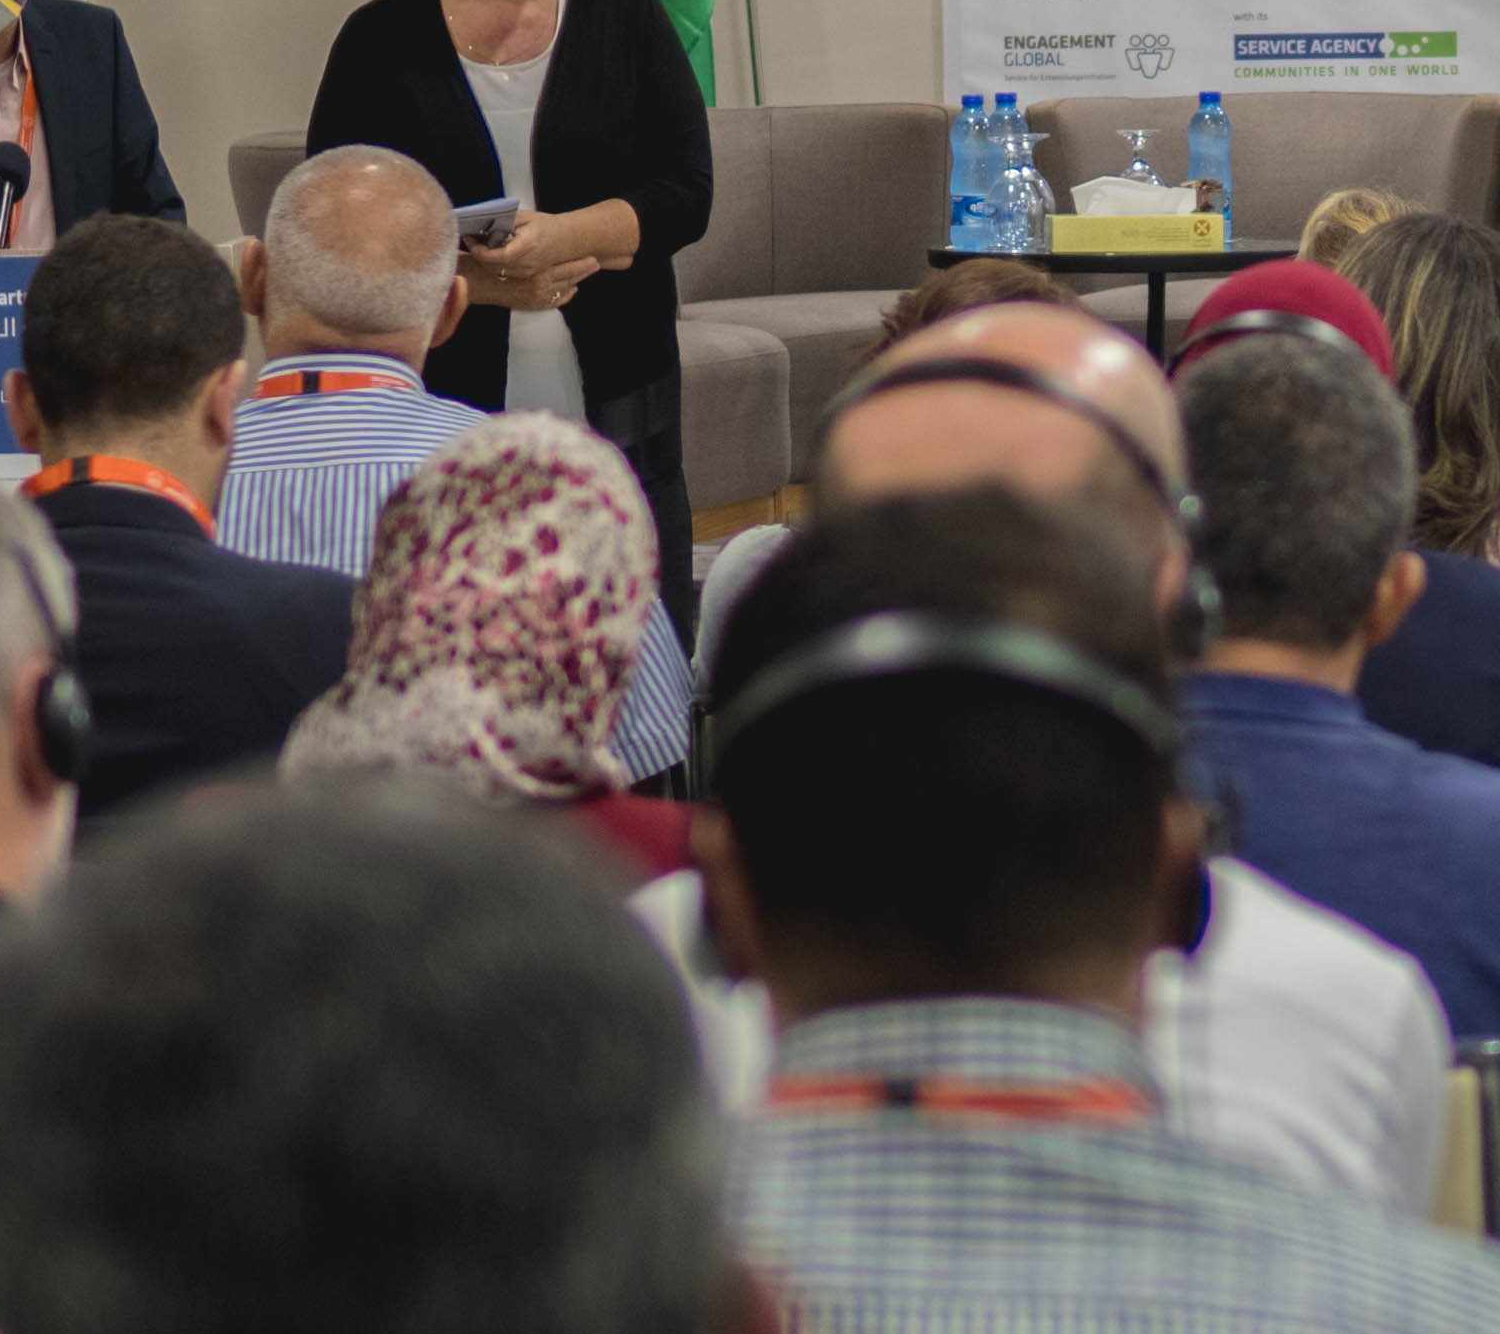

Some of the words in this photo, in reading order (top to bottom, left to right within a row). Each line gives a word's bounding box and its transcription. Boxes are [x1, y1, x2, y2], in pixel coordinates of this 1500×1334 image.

[1003, 34, 1116, 50] ENGAGEMENT
[1237, 39, 1307, 55] SERVICE
[1310, 38, 1377, 54] AGENCY
[1003, 51, 1065, 68] GLOBAL
[1233, 65, 1335, 79] COMMUNITIES
[1344, 65, 1360, 77] IN
[1368, 64, 1397, 77] ONE
[1405, 64, 1459, 76] WORLD
